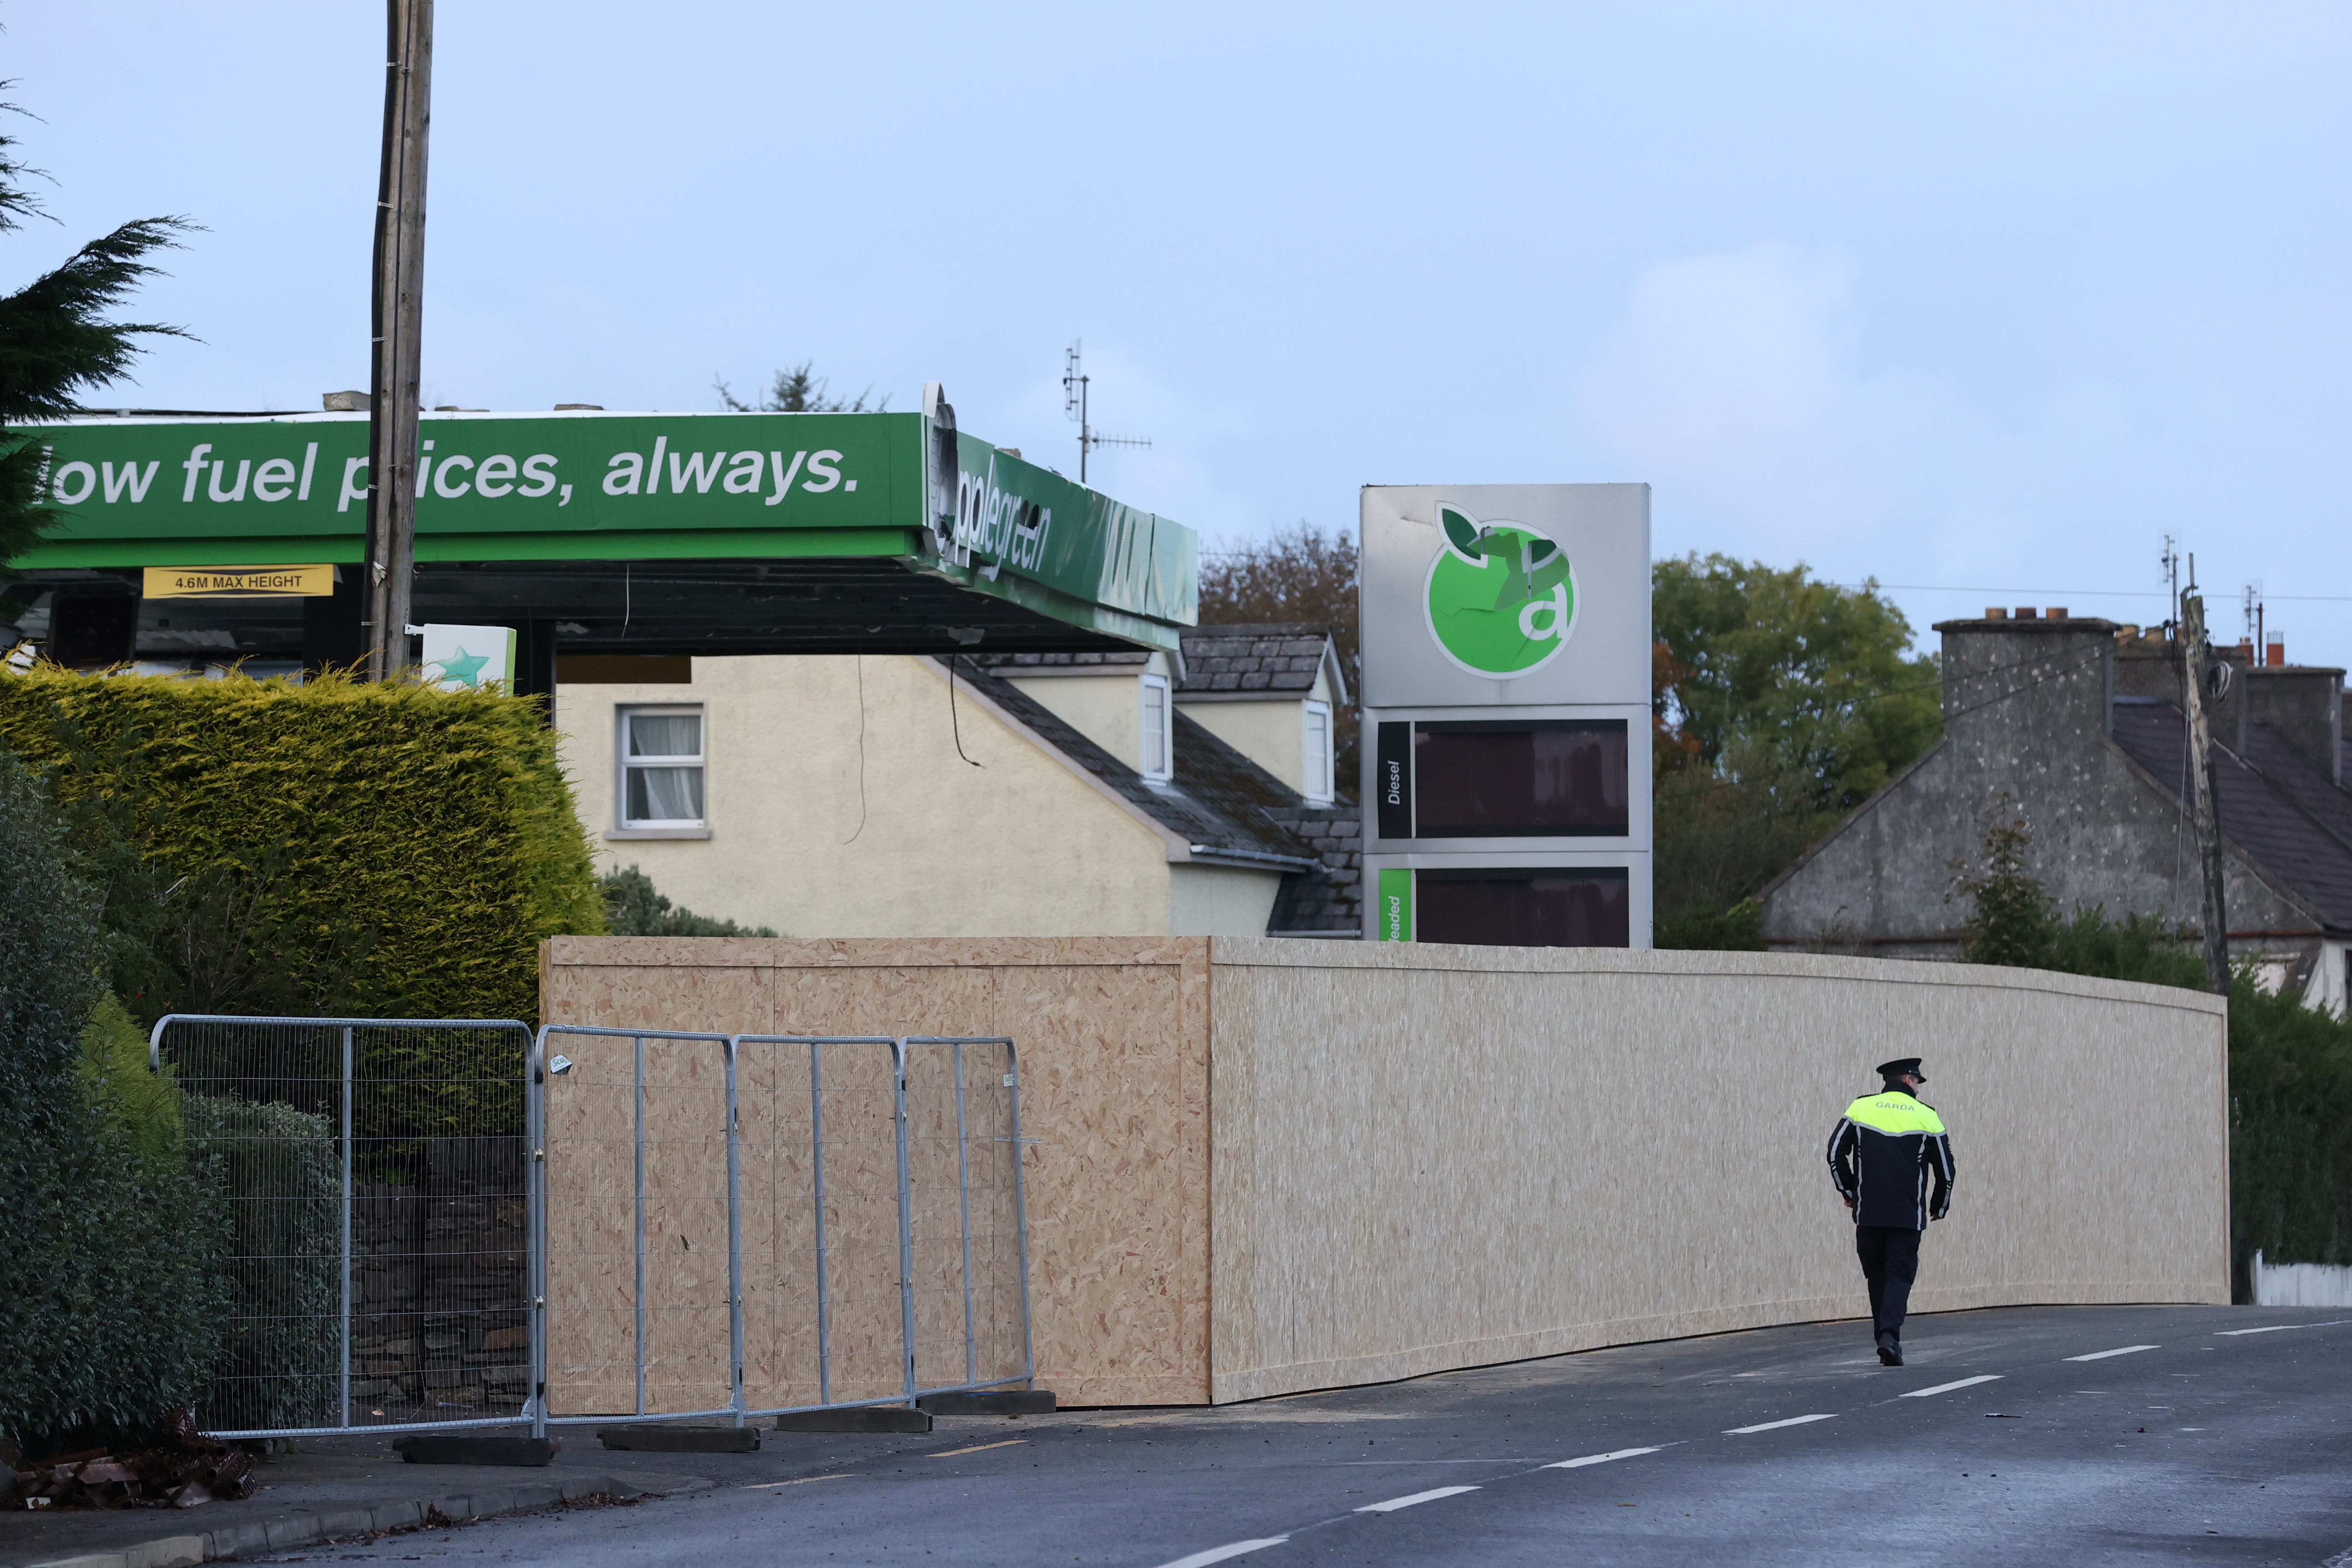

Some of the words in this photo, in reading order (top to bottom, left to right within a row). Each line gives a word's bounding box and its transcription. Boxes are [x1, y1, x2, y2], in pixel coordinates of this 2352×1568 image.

[32, 445, 161, 505] low
[182, 441, 319, 503] fuel
[337, 439, 573, 513] pices,
[602, 435, 858, 506] always.
[175, 577, 207, 588] 4.6M
[213, 576, 244, 588] MAX
[248, 576, 302, 587] HEIGHT
[1388, 760, 1400, 805] Diesel
[1876, 1102, 1915, 1111] GARDA
